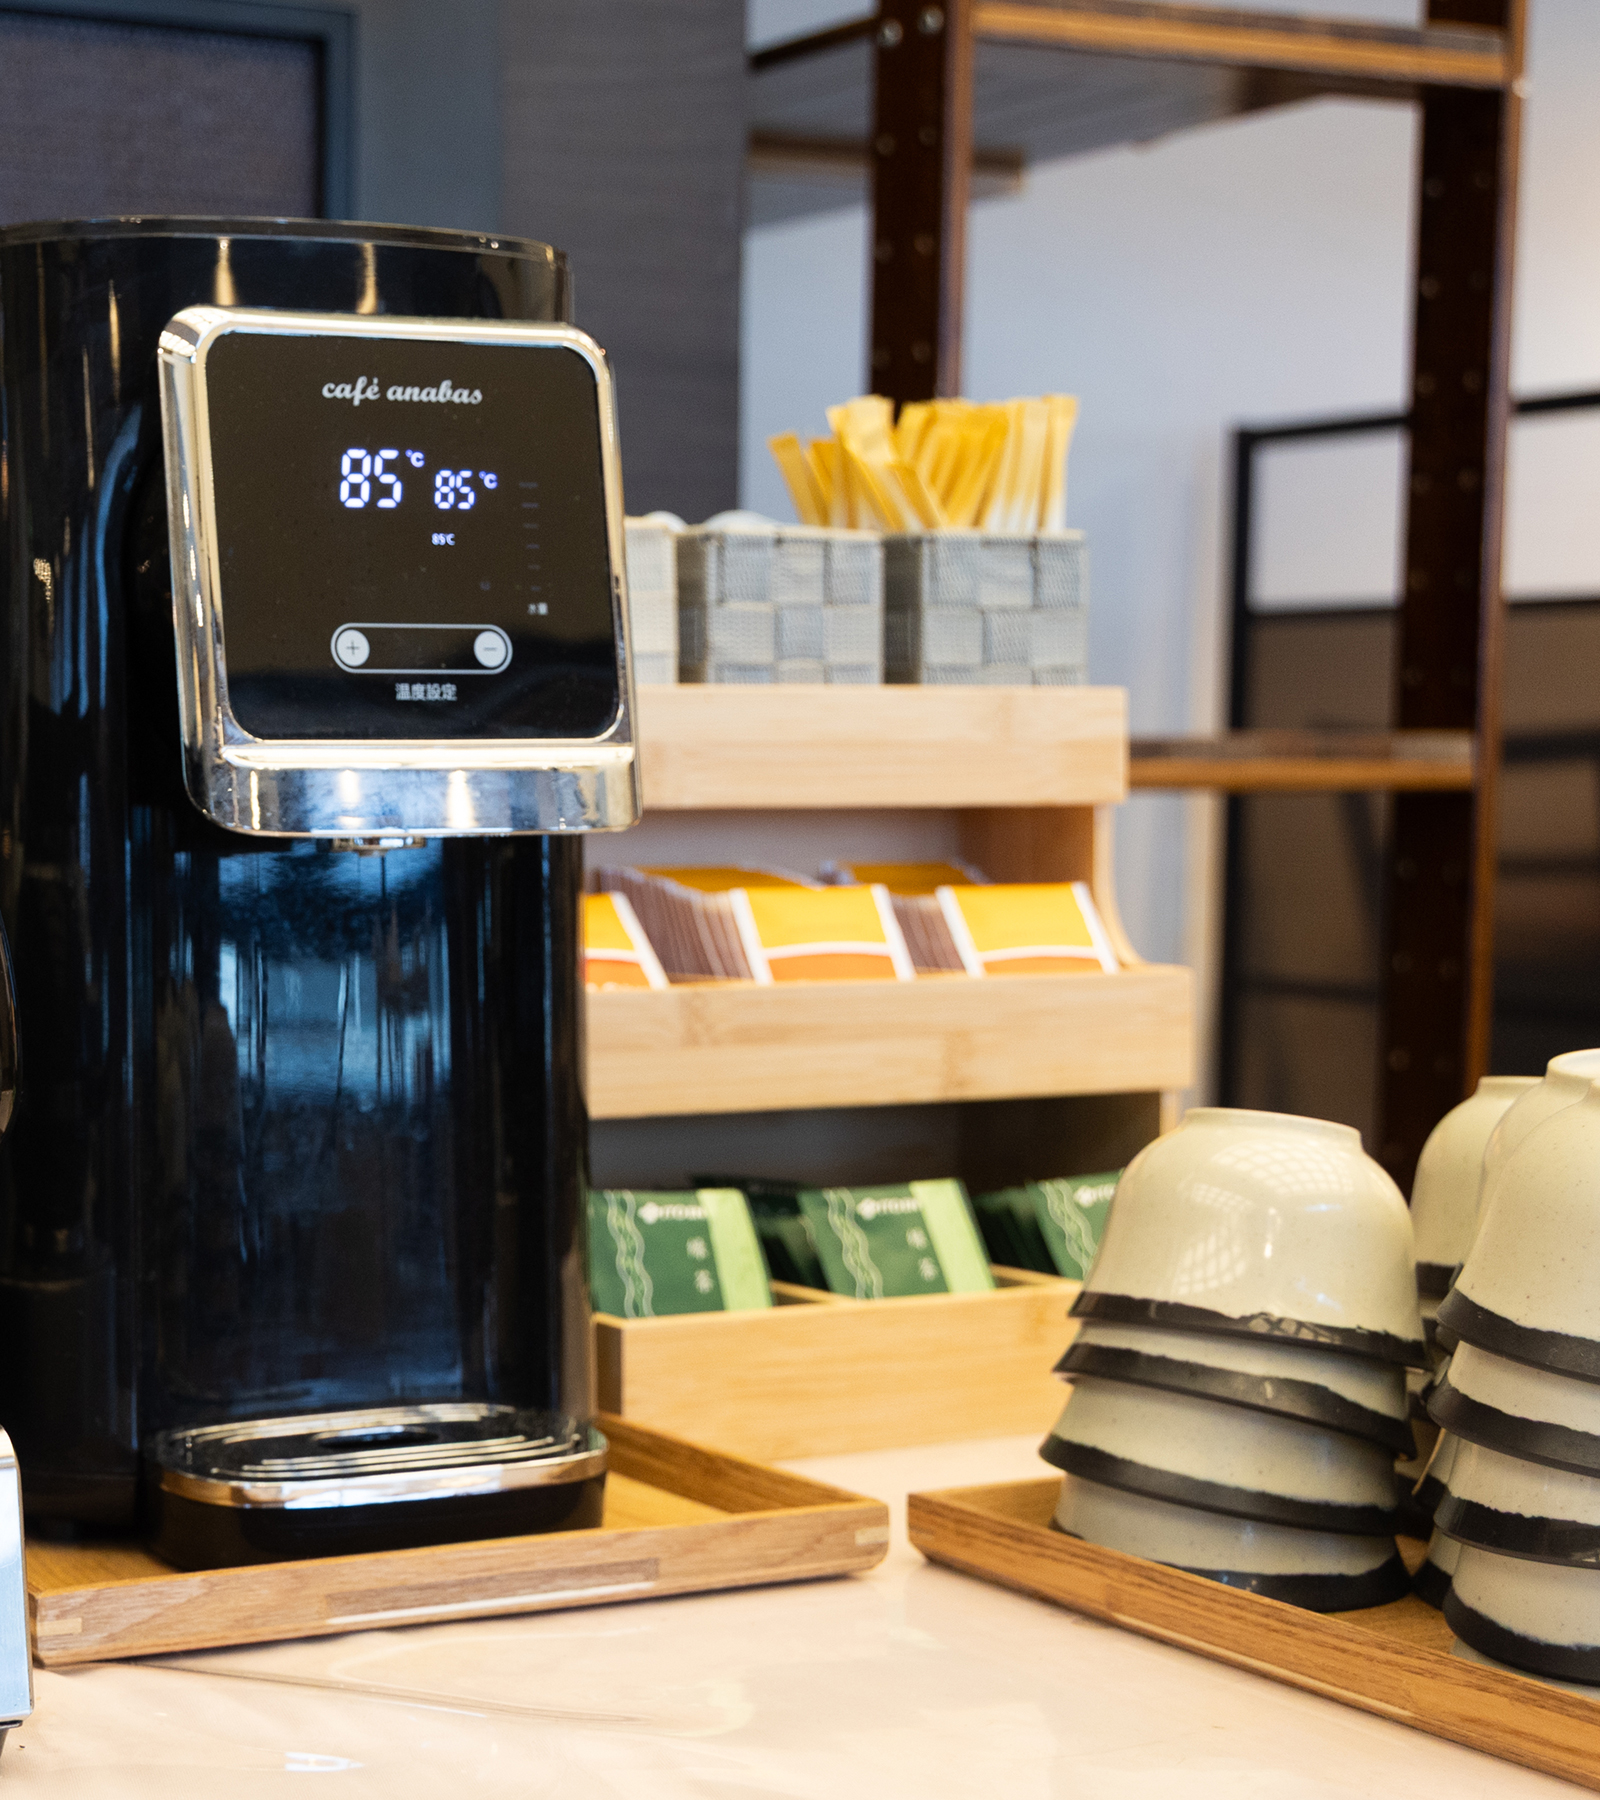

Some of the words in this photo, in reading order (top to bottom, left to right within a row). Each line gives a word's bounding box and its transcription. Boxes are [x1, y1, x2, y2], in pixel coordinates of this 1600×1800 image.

[322, 376, 380, 407] café
[386, 379, 483, 405] anabas
[395, 683, 457, 701] 温度設定
